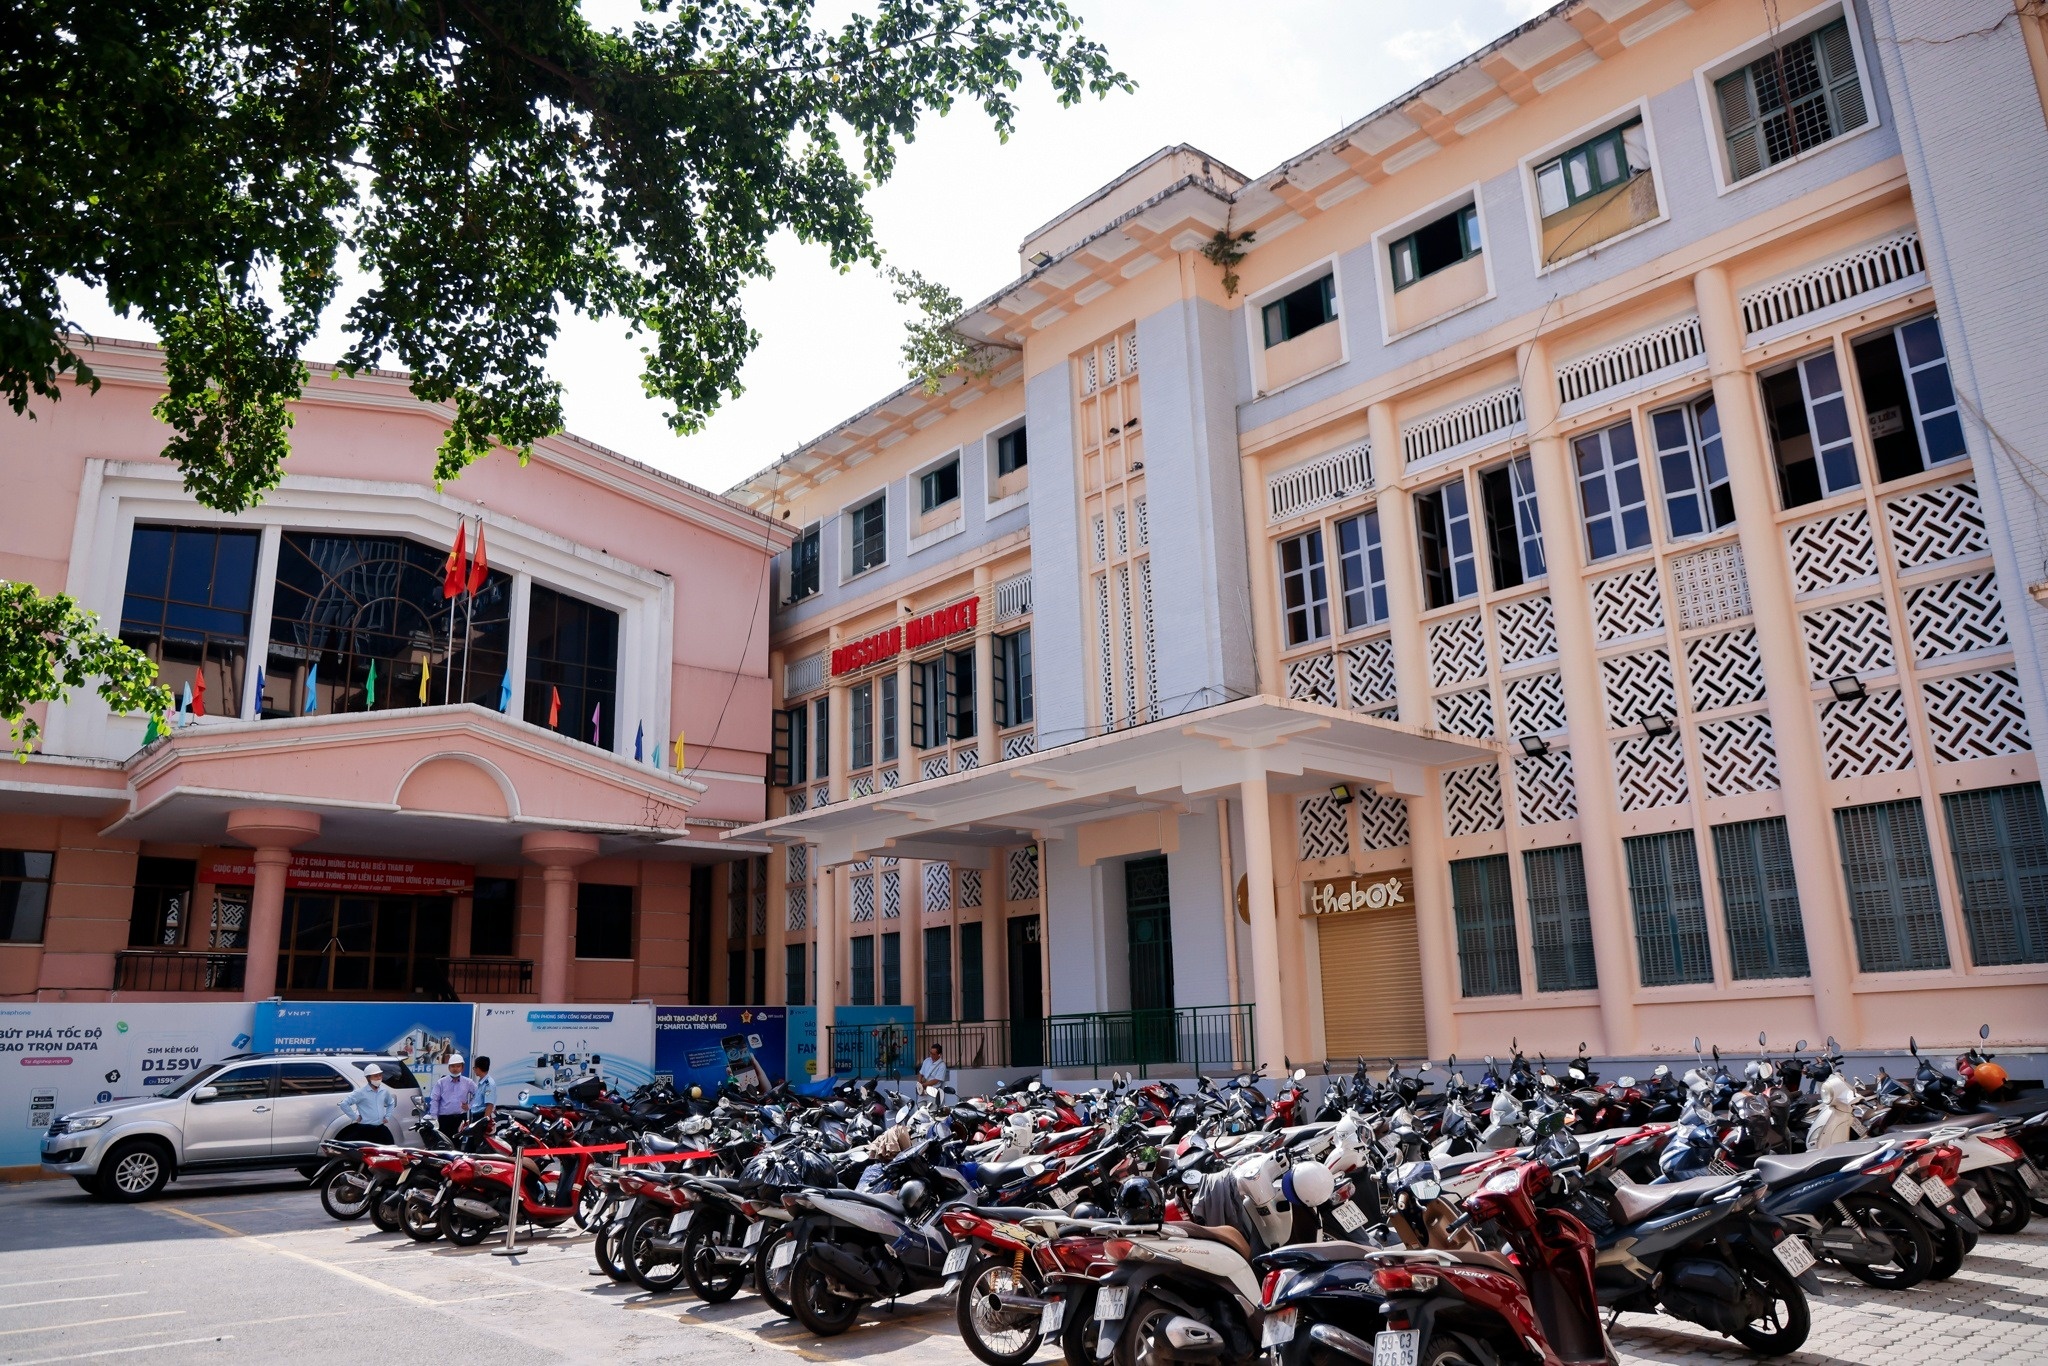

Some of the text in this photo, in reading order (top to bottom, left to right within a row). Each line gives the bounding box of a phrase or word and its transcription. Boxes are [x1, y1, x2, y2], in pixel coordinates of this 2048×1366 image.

[832, 596, 980, 676] RUSSIAN MARKET
[213, 864, 231, 874] CUỘC
[233, 865, 246, 875] HỌP
[310, 857, 327, 867] CHÀO
[347, 859, 360, 869] CÁC
[388, 863, 404, 872] THAM
[289, 868, 310, 877] THỐNG
[311, 870, 324, 879] BAN
[325, 870, 346, 880] THÔNG
[347, 872, 357, 881] TIN
[358, 872, 371, 882] LIÊN
[372, 874, 384, 883] LẠC
[385, 875, 404, 884] TRUNG
[423, 877, 435, 886] CỤC
[451, 879, 465, 887] NAM
[1311, 877, 1404, 914] thebox
[673, 1015, 685, 1023] TẠO
[686, 1013, 699, 1022] CHỮ
[708, 1012, 718, 1022] SỐ
[0, 1026, 102, 1040] BỨT PHÁ TỐC ĐỘ
[693, 1022, 709, 1030] TRÊN
[0, 1042, 98, 1053] BAO TRỌN DATA
[275, 1037, 316, 1045] INTERNET
[837, 1042, 864, 1053] SAFE
[141, 1058, 202, 1071] D159V
[1662, 1210, 1712, 1231] AIRBLADE
[1778, 1239, 1801, 1259] 59-GA
[1787, 1250, 1812, 1273] 179.01
[1453, 1269, 1489, 1279] VISION
[1381, 1332, 1412, 1351] 59-C3
